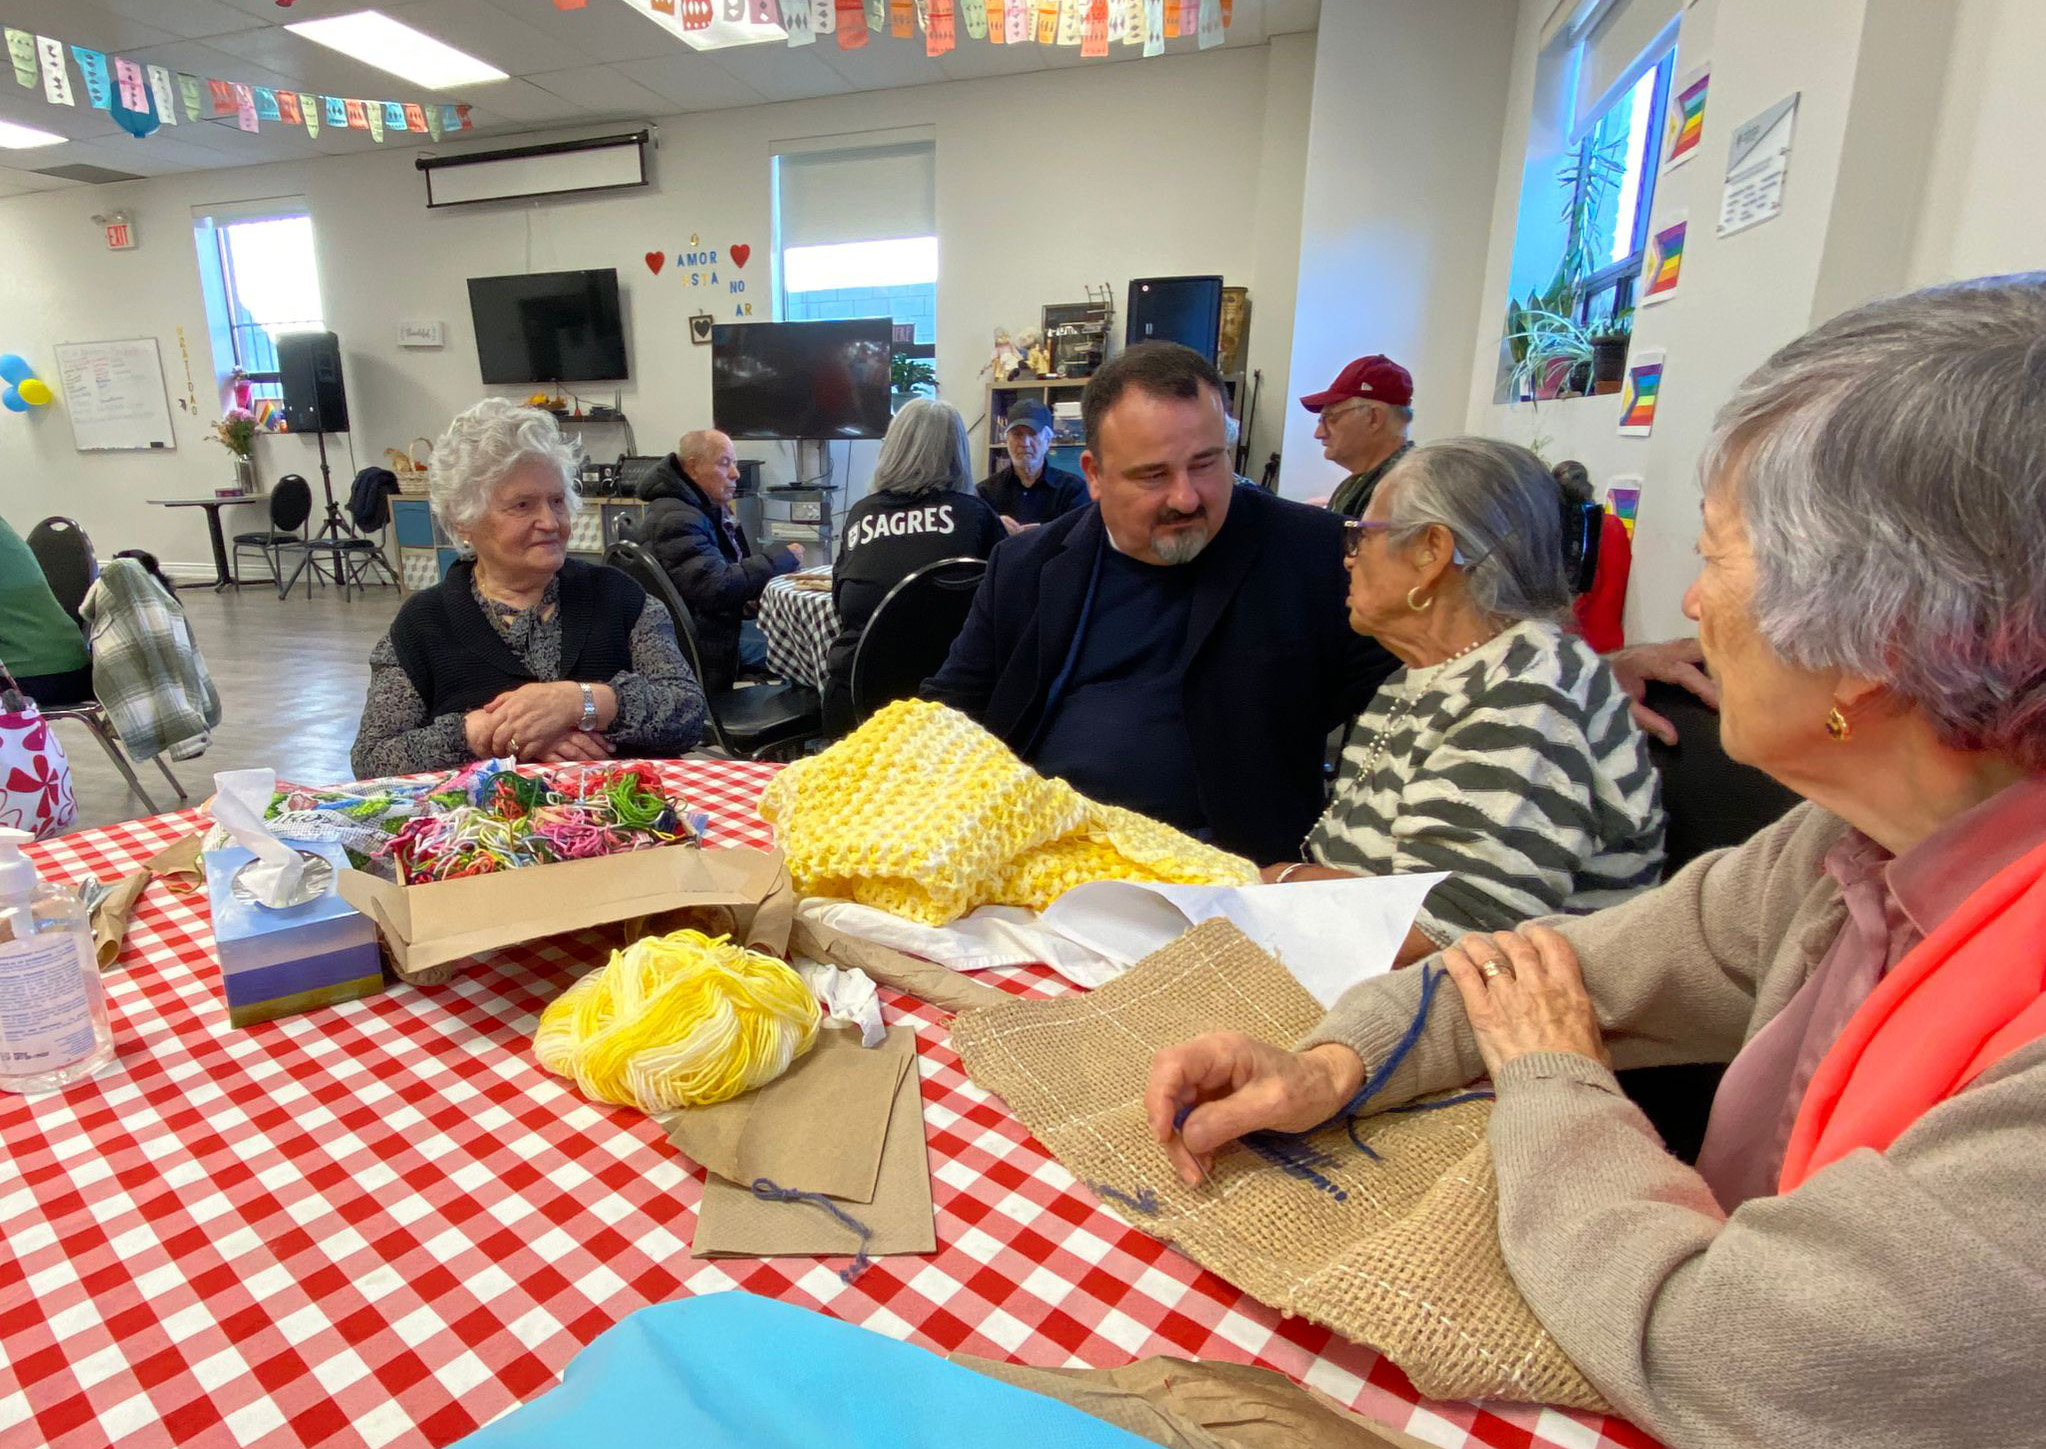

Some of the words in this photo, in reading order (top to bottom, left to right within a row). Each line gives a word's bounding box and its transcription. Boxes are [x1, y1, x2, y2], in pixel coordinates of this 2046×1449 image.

[107, 225, 128, 246] EXIT
[677, 251, 717, 267] AMOR
[729, 280, 745, 294] NO
[735, 303, 752, 317] AR
[860, 505, 955, 544] SAGRES
